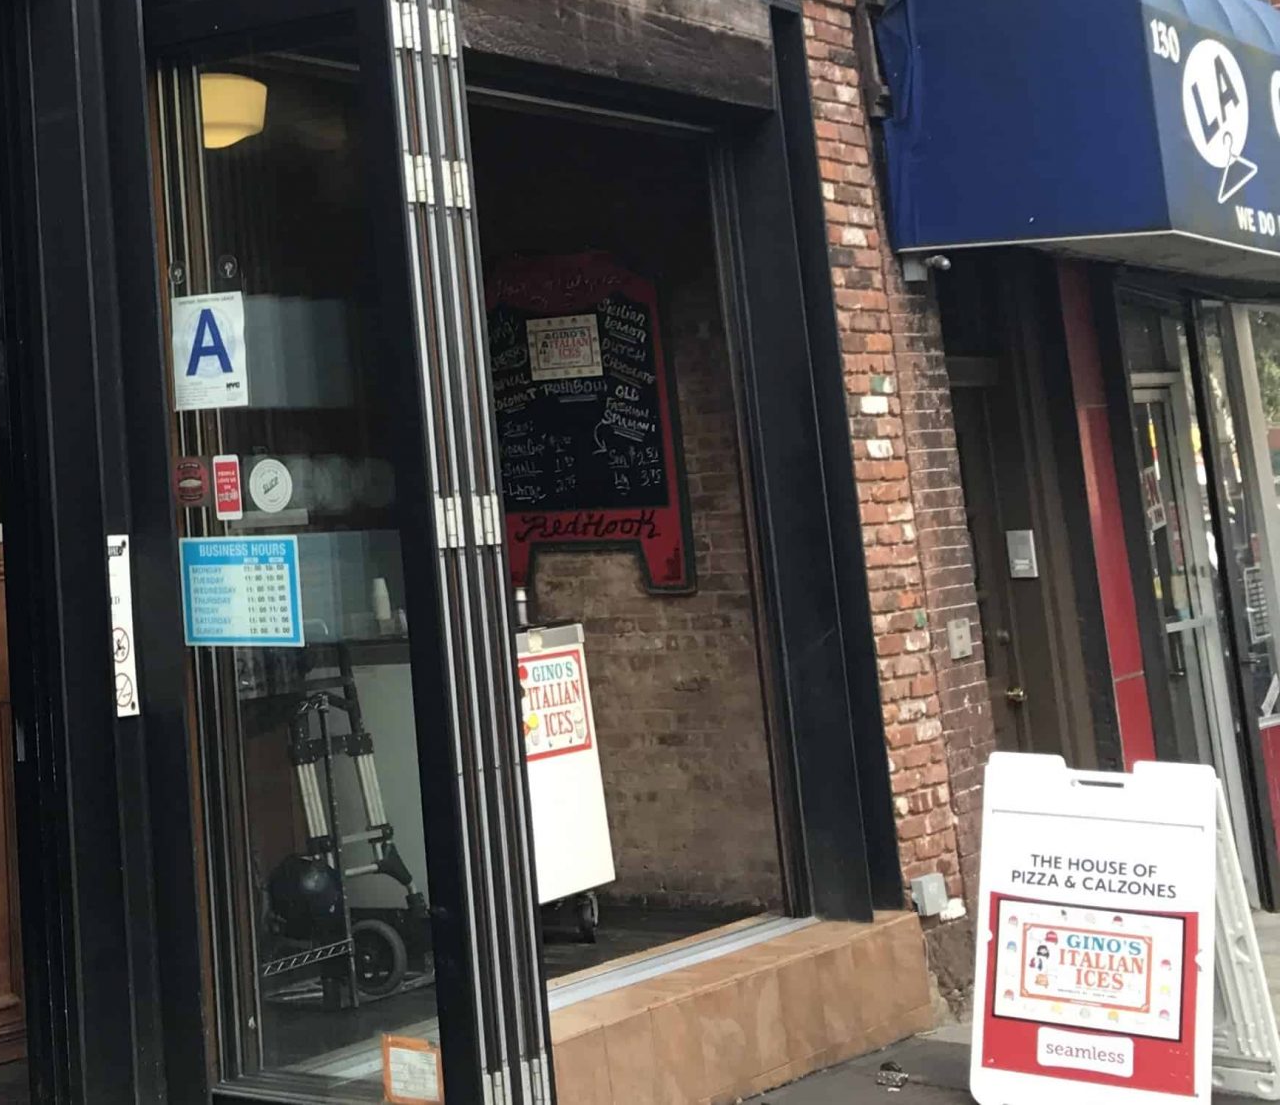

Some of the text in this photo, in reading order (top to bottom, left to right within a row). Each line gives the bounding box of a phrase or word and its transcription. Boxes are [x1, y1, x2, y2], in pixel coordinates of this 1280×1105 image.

[1150, 19, 1180, 64] 130
[1191, 54, 1240, 145] LA
[1235, 205, 1257, 233] WE
[1257, 209, 1276, 236] DO
[186, 308, 234, 377] A
[199, 542, 287, 557] BUSINESS HOURS
[532, 661, 573, 683] GINO'S
[527, 680, 581, 711] ITALIAN
[543, 710, 574, 738] ICES
[1031, 854, 1158, 878] THE HOUSE OF
[1011, 870, 1177, 899] PIZZA & CALZONES
[1066, 934, 1142, 956] GINO'S
[1058, 948, 1145, 975] ITALIAN
[1075, 969, 1124, 991] ICES
[1046, 1043, 1125, 1064] seamless
